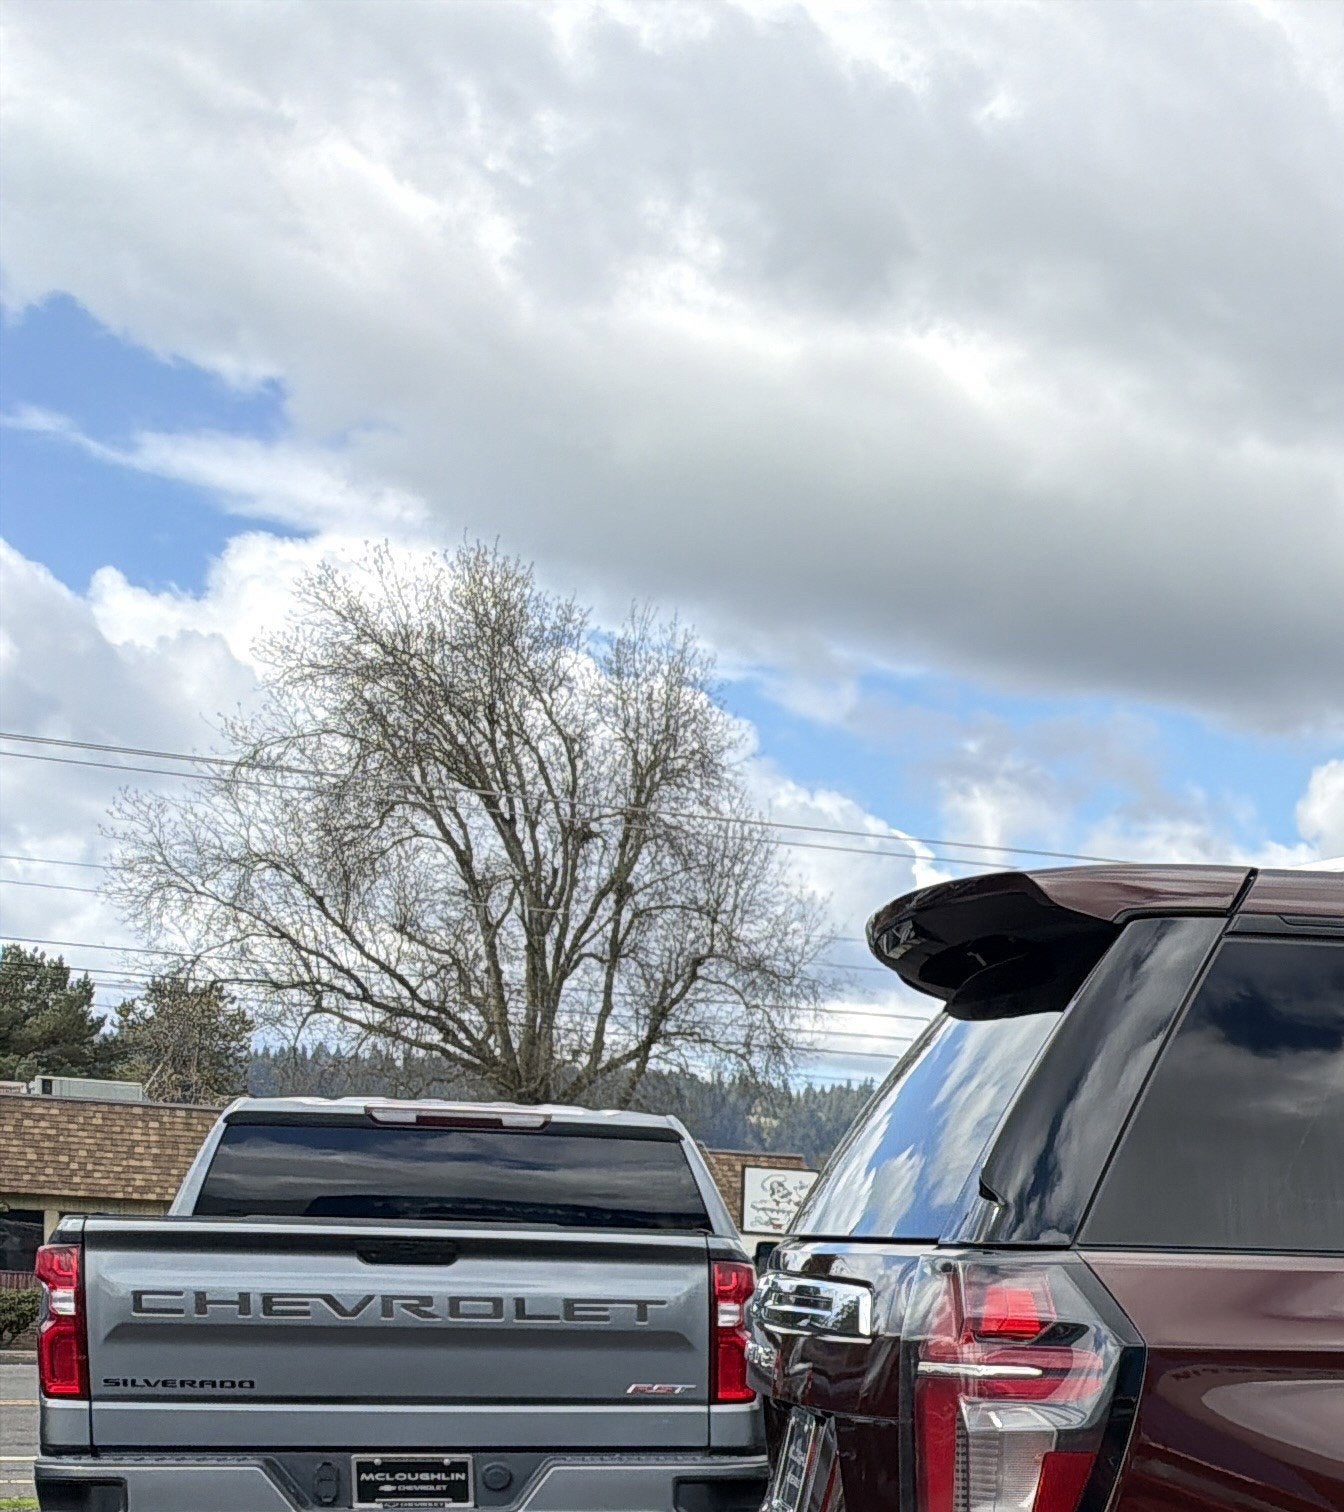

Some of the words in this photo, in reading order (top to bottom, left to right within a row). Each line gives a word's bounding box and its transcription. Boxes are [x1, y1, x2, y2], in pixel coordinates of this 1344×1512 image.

[130, 1289, 669, 1325] CHEVROLET
[102, 1378, 256, 1389] SILVERADO
[626, 1383, 697, 1394] RST
[360, 1472, 466, 1481] MCLOUGHLIN
